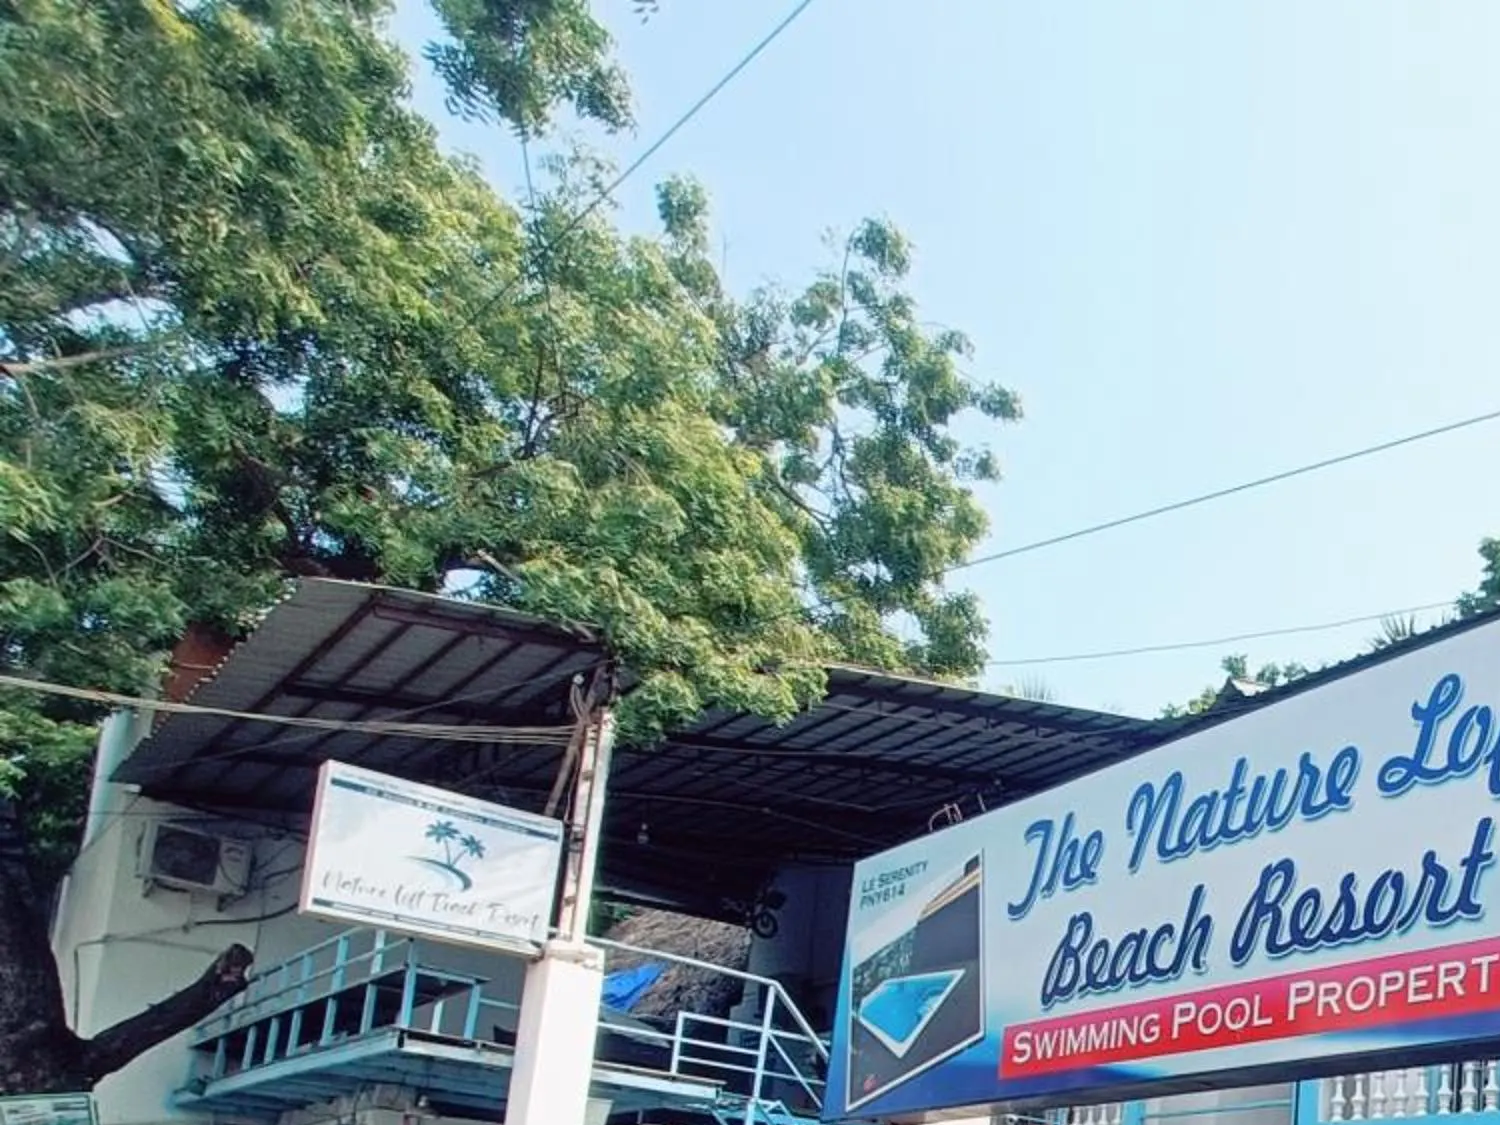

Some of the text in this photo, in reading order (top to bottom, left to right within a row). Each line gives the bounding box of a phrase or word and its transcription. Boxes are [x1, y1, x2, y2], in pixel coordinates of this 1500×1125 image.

[1006, 811, 1104, 918] The
[1125, 745, 1360, 873] Nature
[1040, 816, 1495, 1007] Beach Resort
[1011, 1012, 1161, 1064] SWIMMING
[1171, 998, 1273, 1040] POOL
